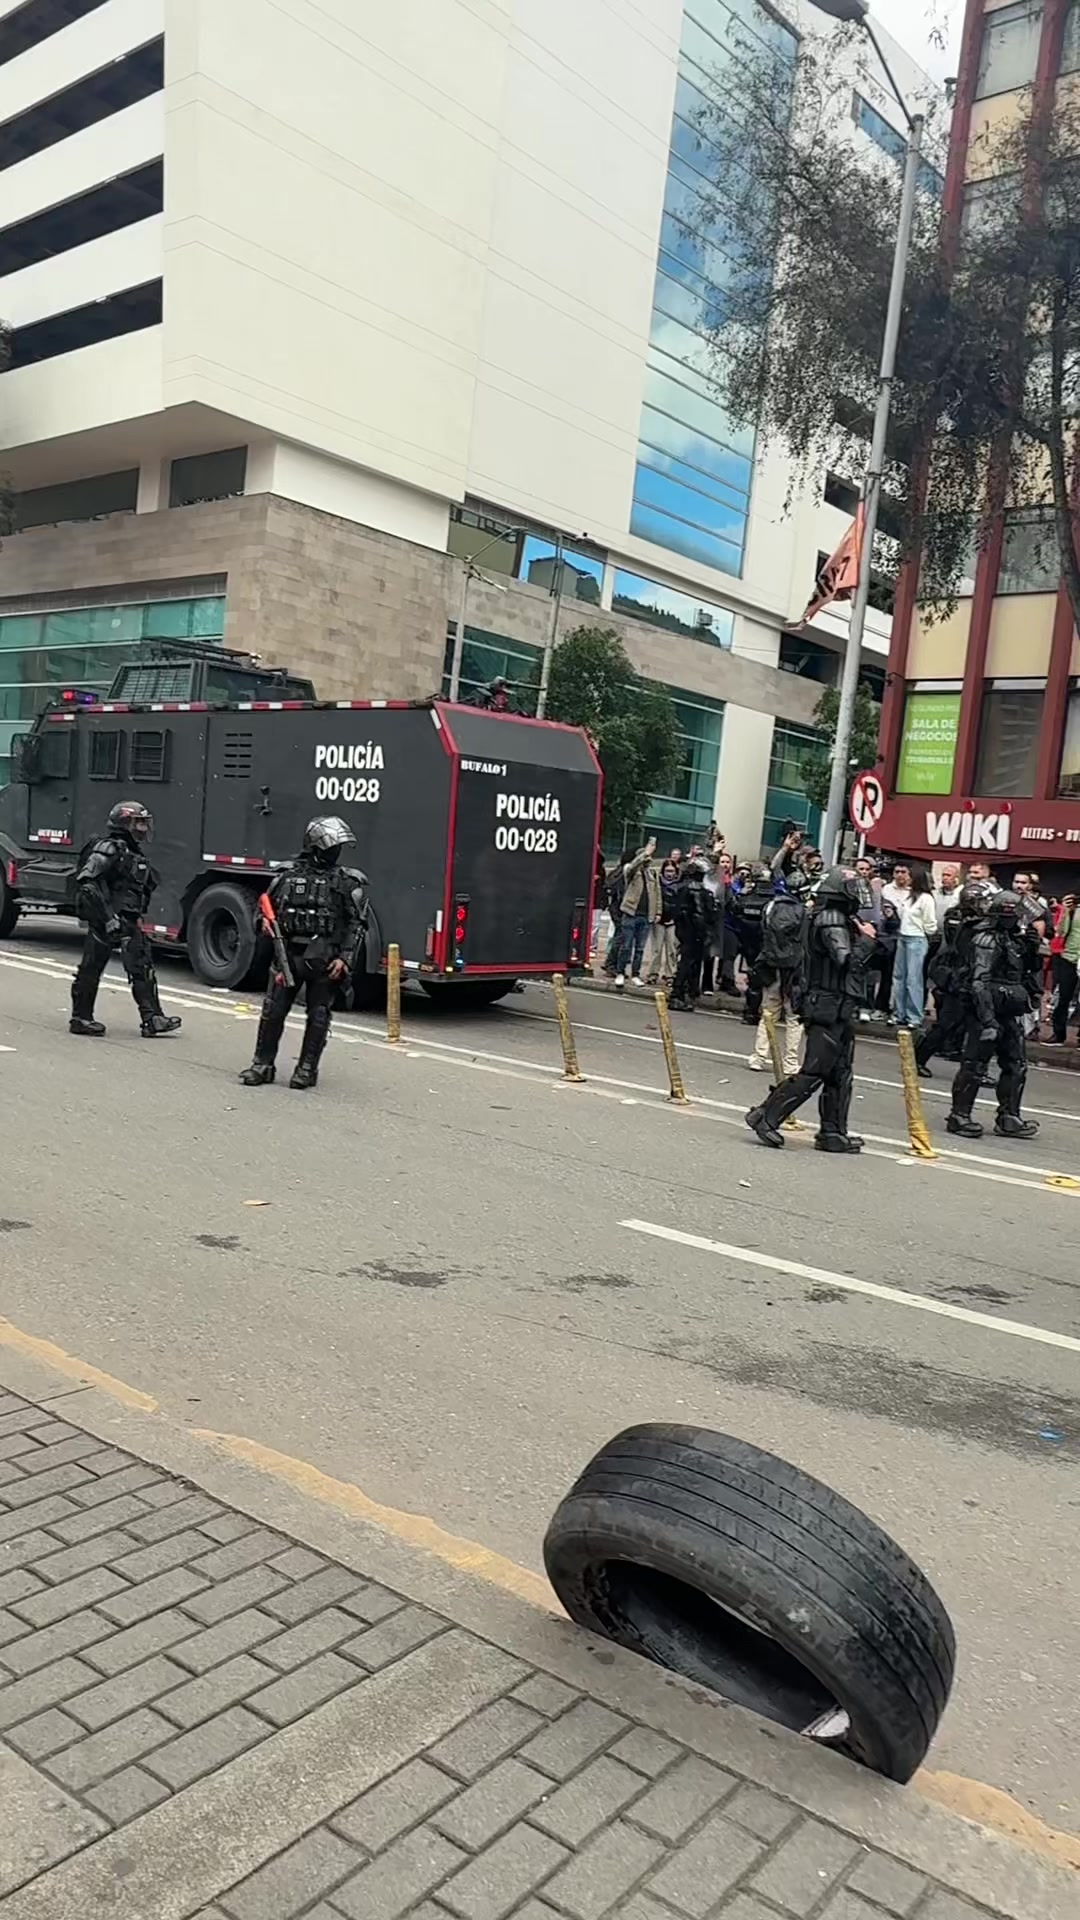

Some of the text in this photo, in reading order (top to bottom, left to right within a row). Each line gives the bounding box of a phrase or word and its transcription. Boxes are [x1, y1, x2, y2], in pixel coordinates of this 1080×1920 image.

[911, 719, 957, 729] SALA DE
[315, 740, 384, 769] POLICÍA
[315, 776, 380, 803] 00-028
[861, 781, 878, 821] P
[496, 793, 561, 822] POLICÍA
[495, 826, 558, 853] 00-028
[1020, 826, 1056, 841] ALITAS
